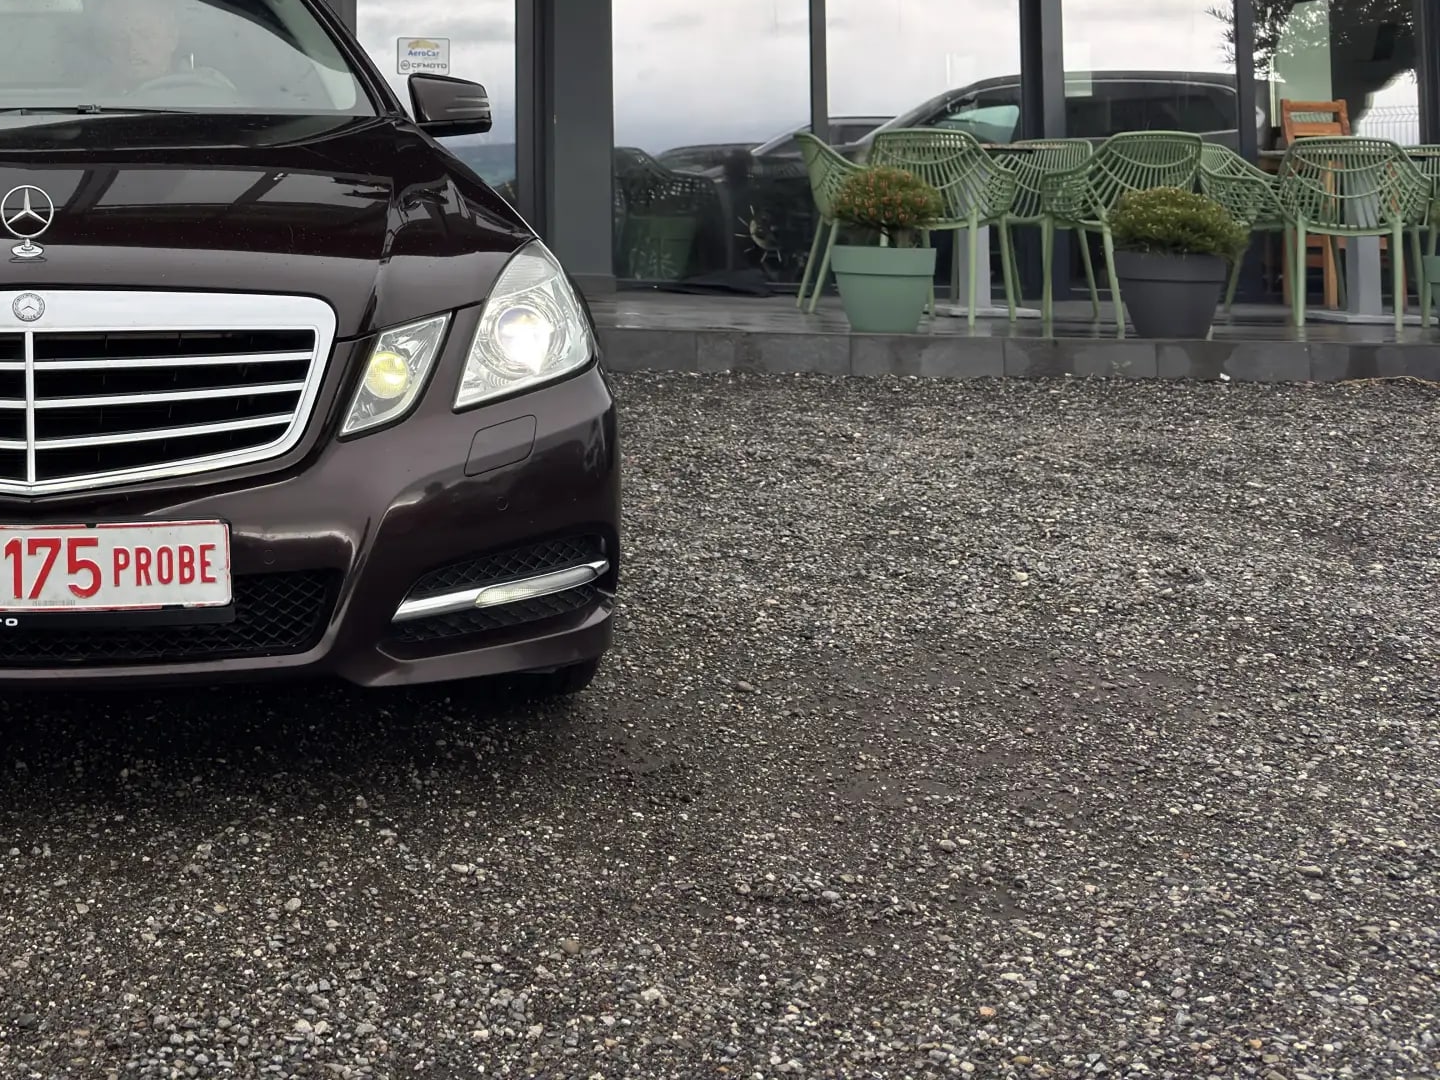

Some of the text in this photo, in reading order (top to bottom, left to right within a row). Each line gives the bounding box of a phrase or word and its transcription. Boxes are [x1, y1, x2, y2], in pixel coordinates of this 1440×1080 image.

[407, 49, 440, 57] AeroCar
[3, 536, 103, 600] 175
[112, 543, 217, 588] PROBE
